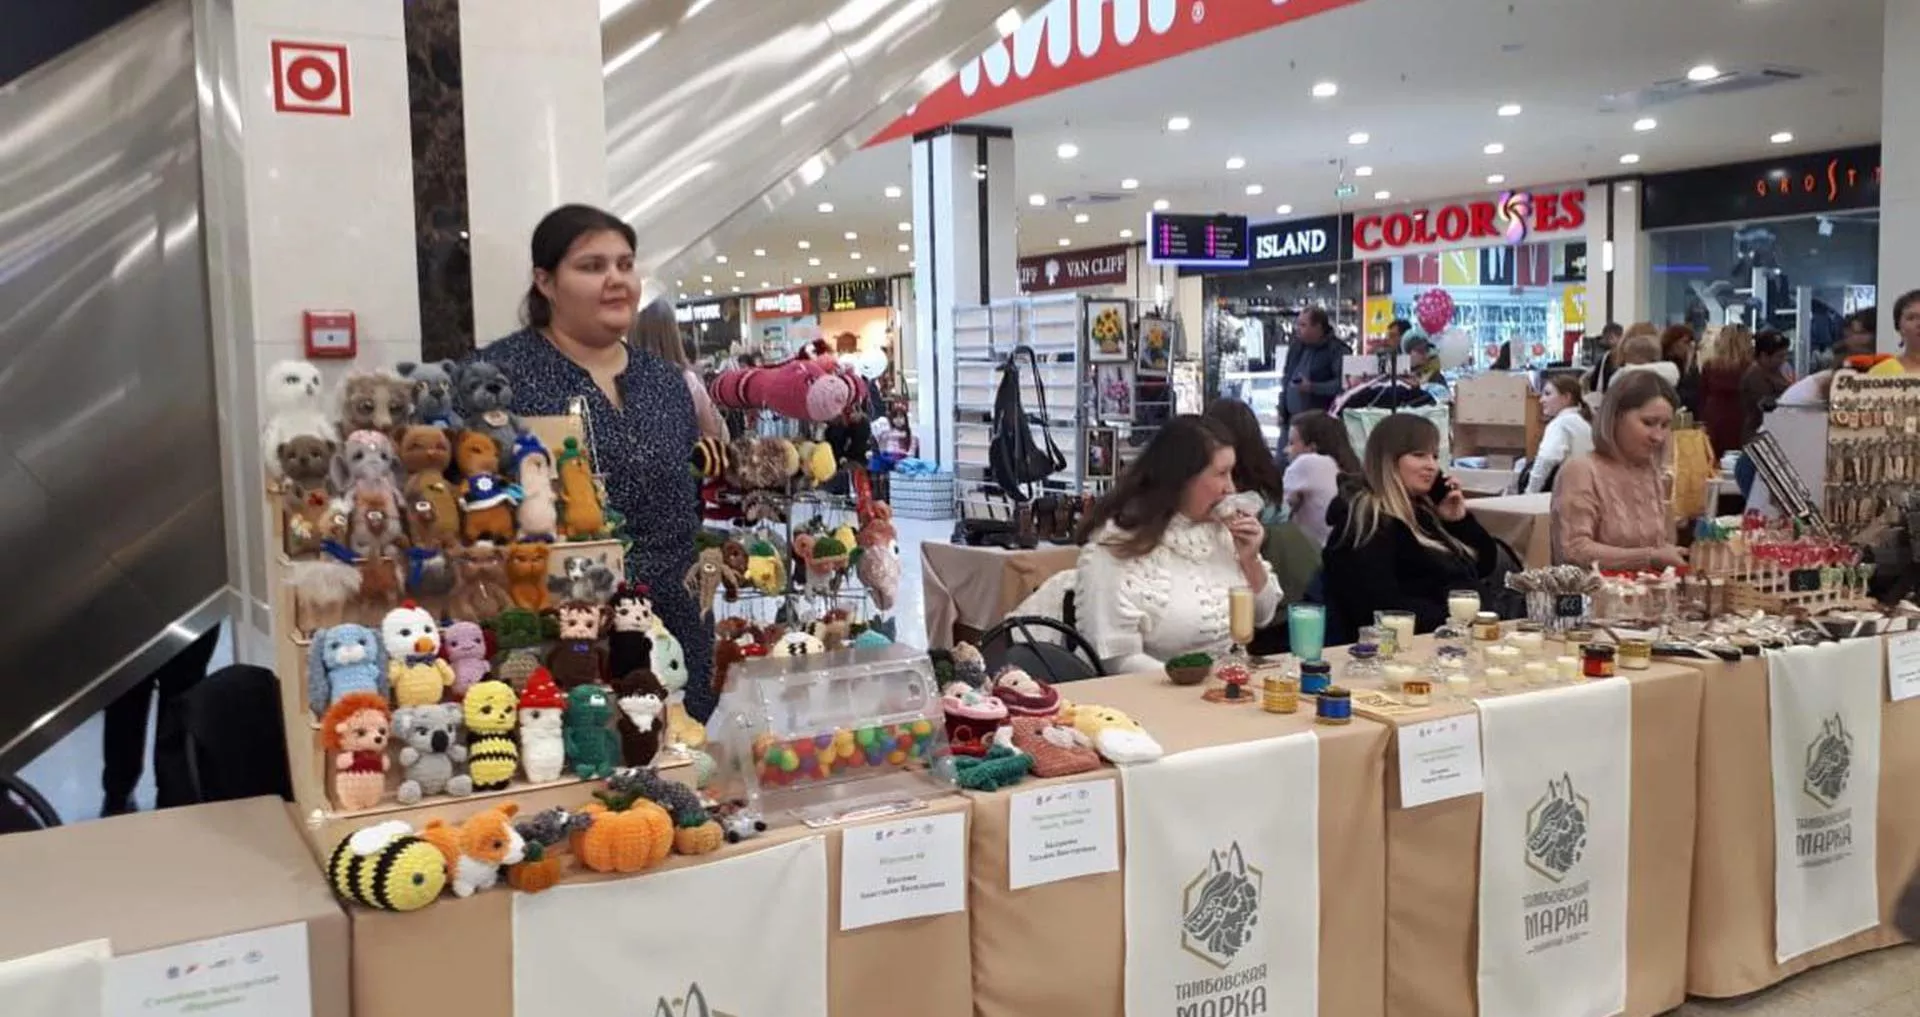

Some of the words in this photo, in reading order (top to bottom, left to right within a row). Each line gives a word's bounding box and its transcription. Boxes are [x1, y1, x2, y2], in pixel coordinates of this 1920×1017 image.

[1256, 230, 1326, 259] ISLAND
[1066, 260, 1090, 278] VAN
[1091, 254, 1125, 275] CLIFF
[1525, 898, 1588, 941] МАРКА
[1175, 963, 1267, 1000] ТАМБОВСКАЯ
